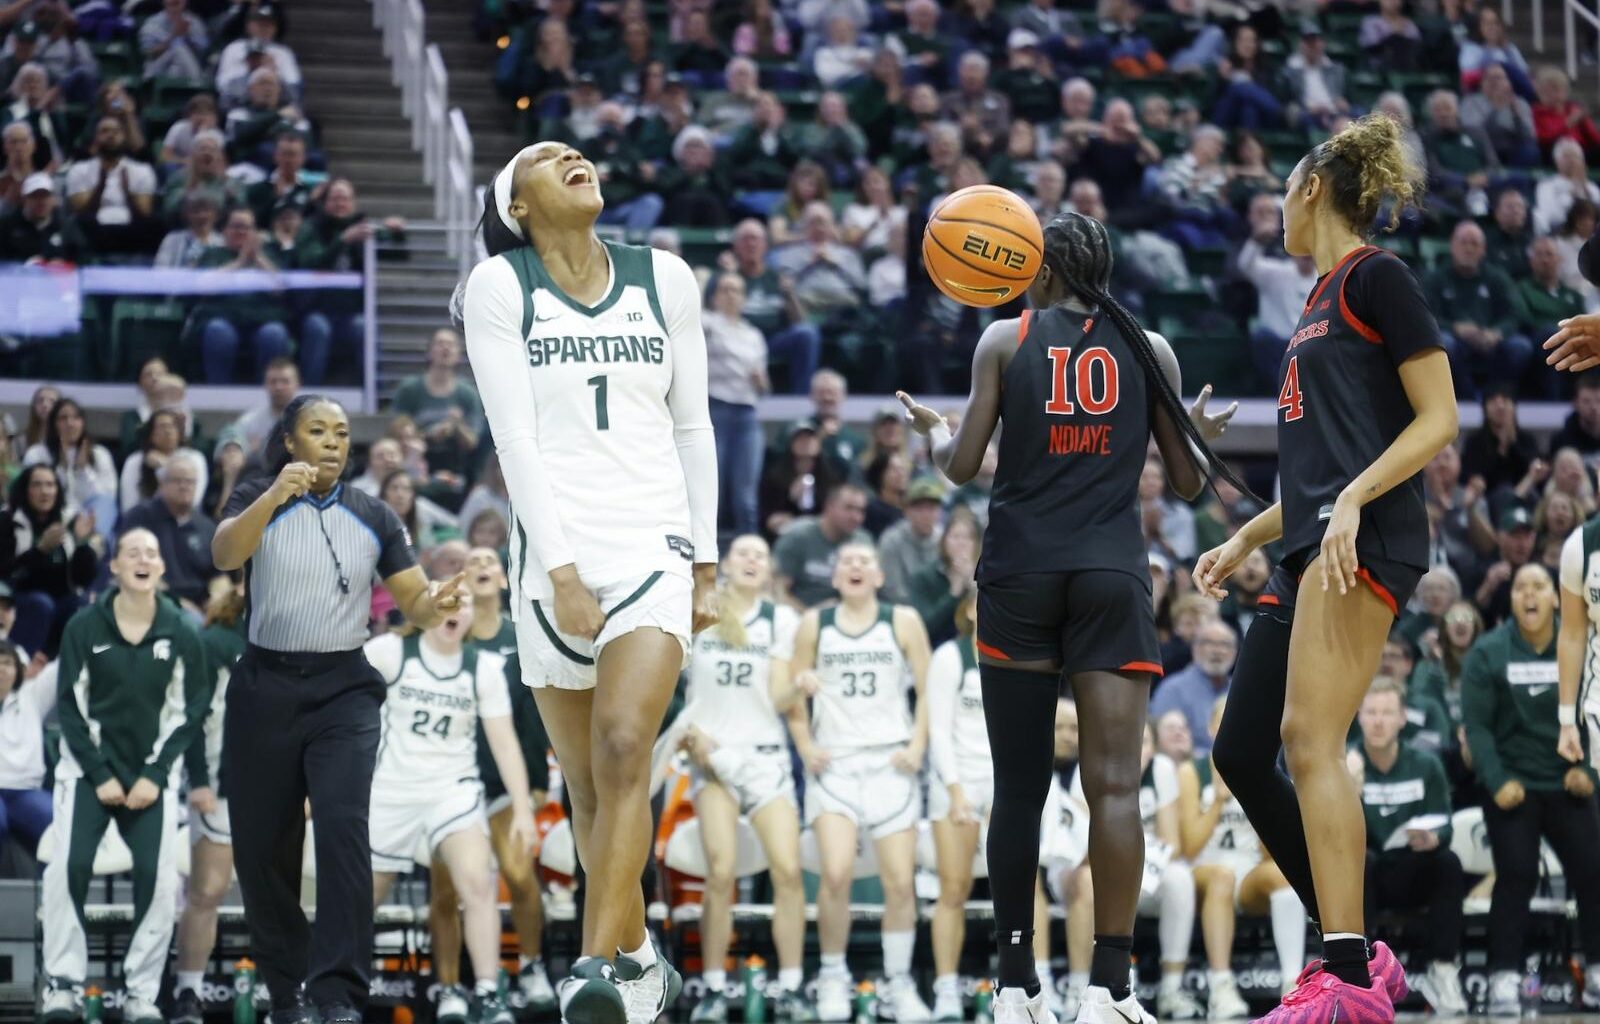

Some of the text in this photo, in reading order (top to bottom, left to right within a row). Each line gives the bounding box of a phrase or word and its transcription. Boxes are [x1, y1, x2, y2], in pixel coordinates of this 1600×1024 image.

[963, 235, 1026, 271] ELITE
[527, 336, 664, 367] SPARTANS
[1046, 346, 1119, 415] 10
[1278, 355, 1303, 422] 4
[587, 375, 609, 430] 1
[1048, 425, 1112, 455] NDIAYE
[717, 661, 752, 687] 32
[823, 651, 893, 667] SPARTANS
[841, 672, 876, 697] 33
[411, 710, 451, 739] 24
